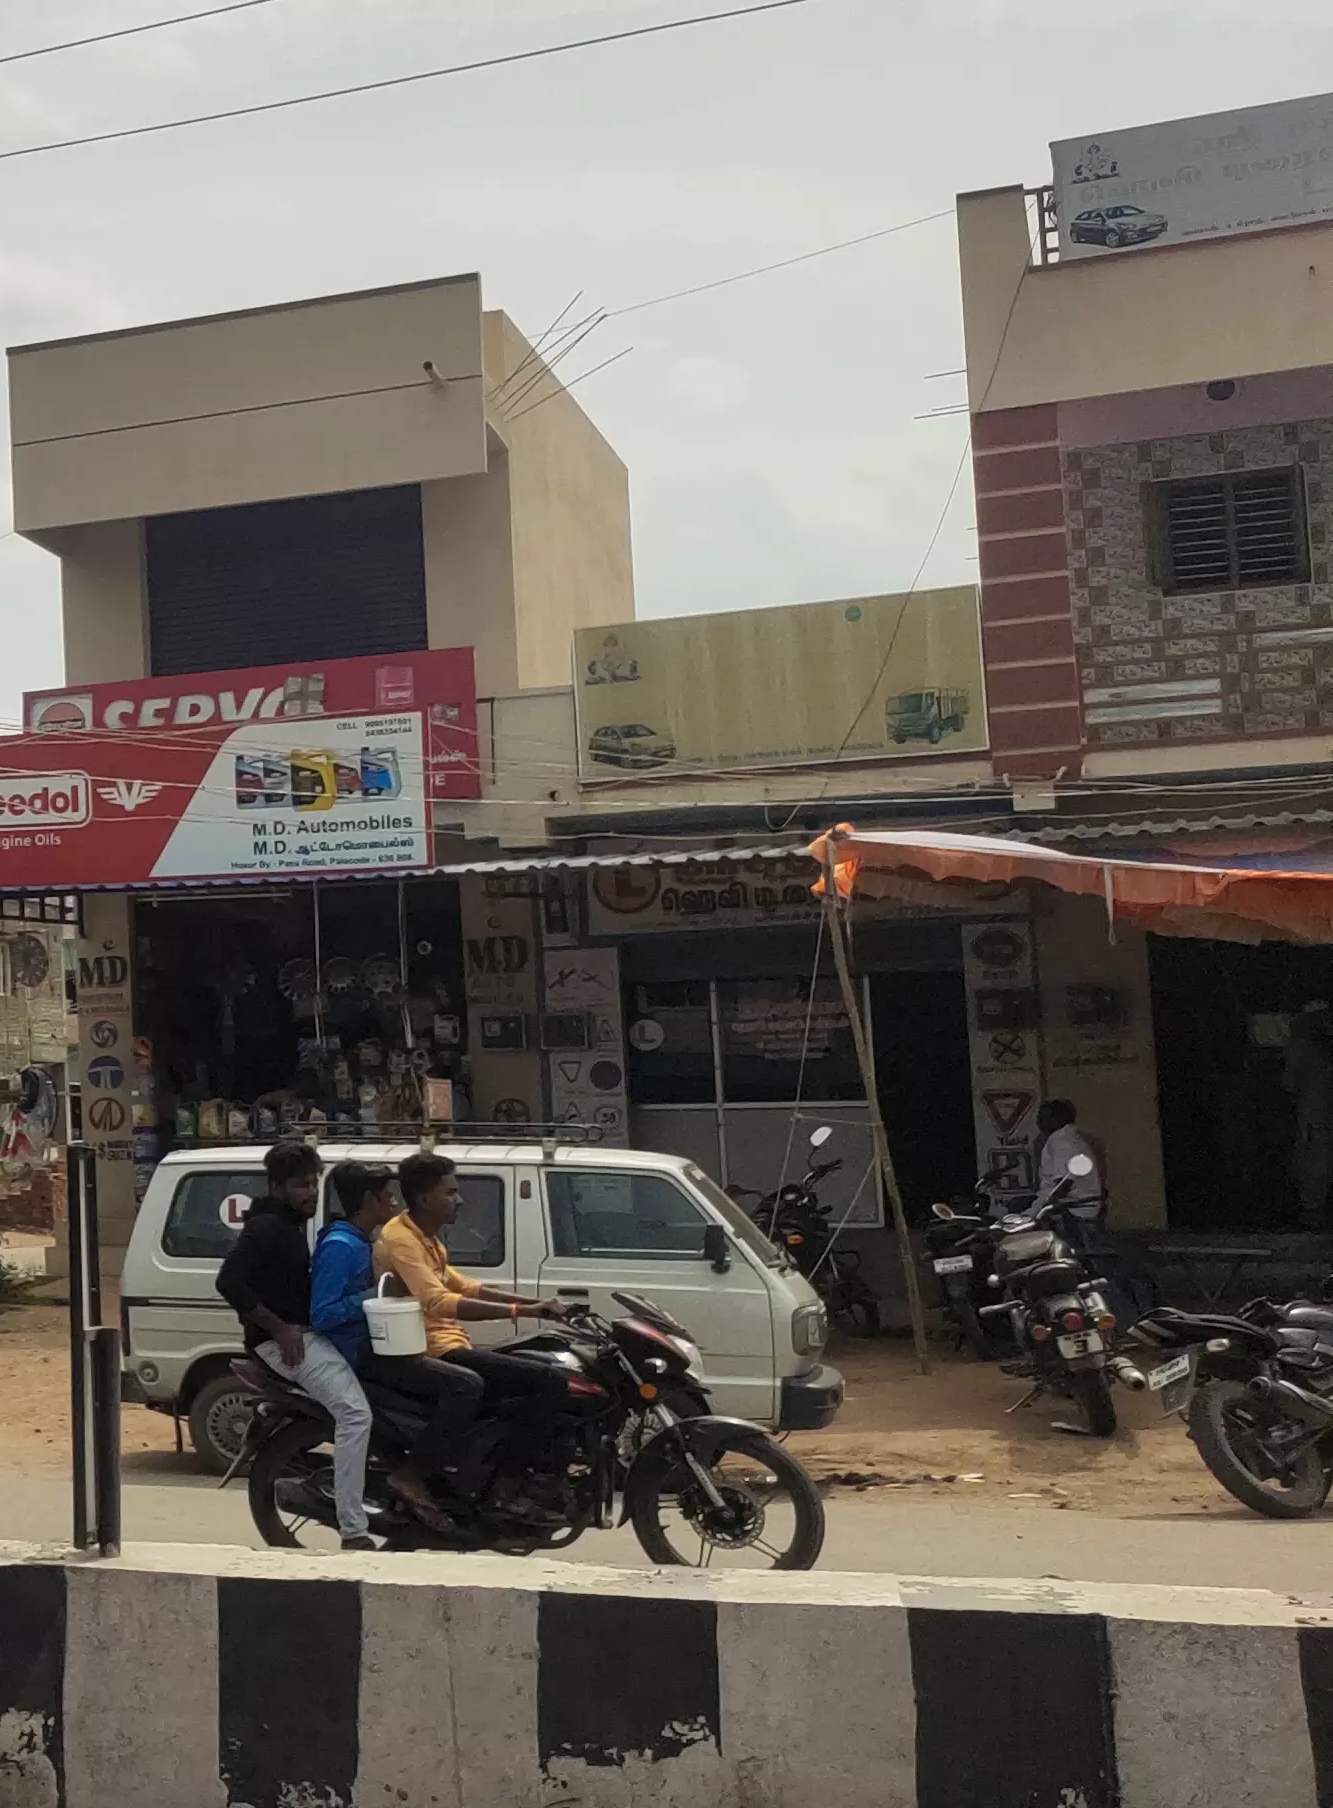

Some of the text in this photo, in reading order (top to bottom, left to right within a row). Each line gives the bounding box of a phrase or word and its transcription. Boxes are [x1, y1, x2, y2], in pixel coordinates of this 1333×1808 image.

[102, 687, 285, 730] SERV
[336, 721, 359, 731] CELL
[252, 814, 413, 837] M.D. Automobiles
[35, 832, 62, 847] Oils
[253, 840, 292, 856] M.D.
